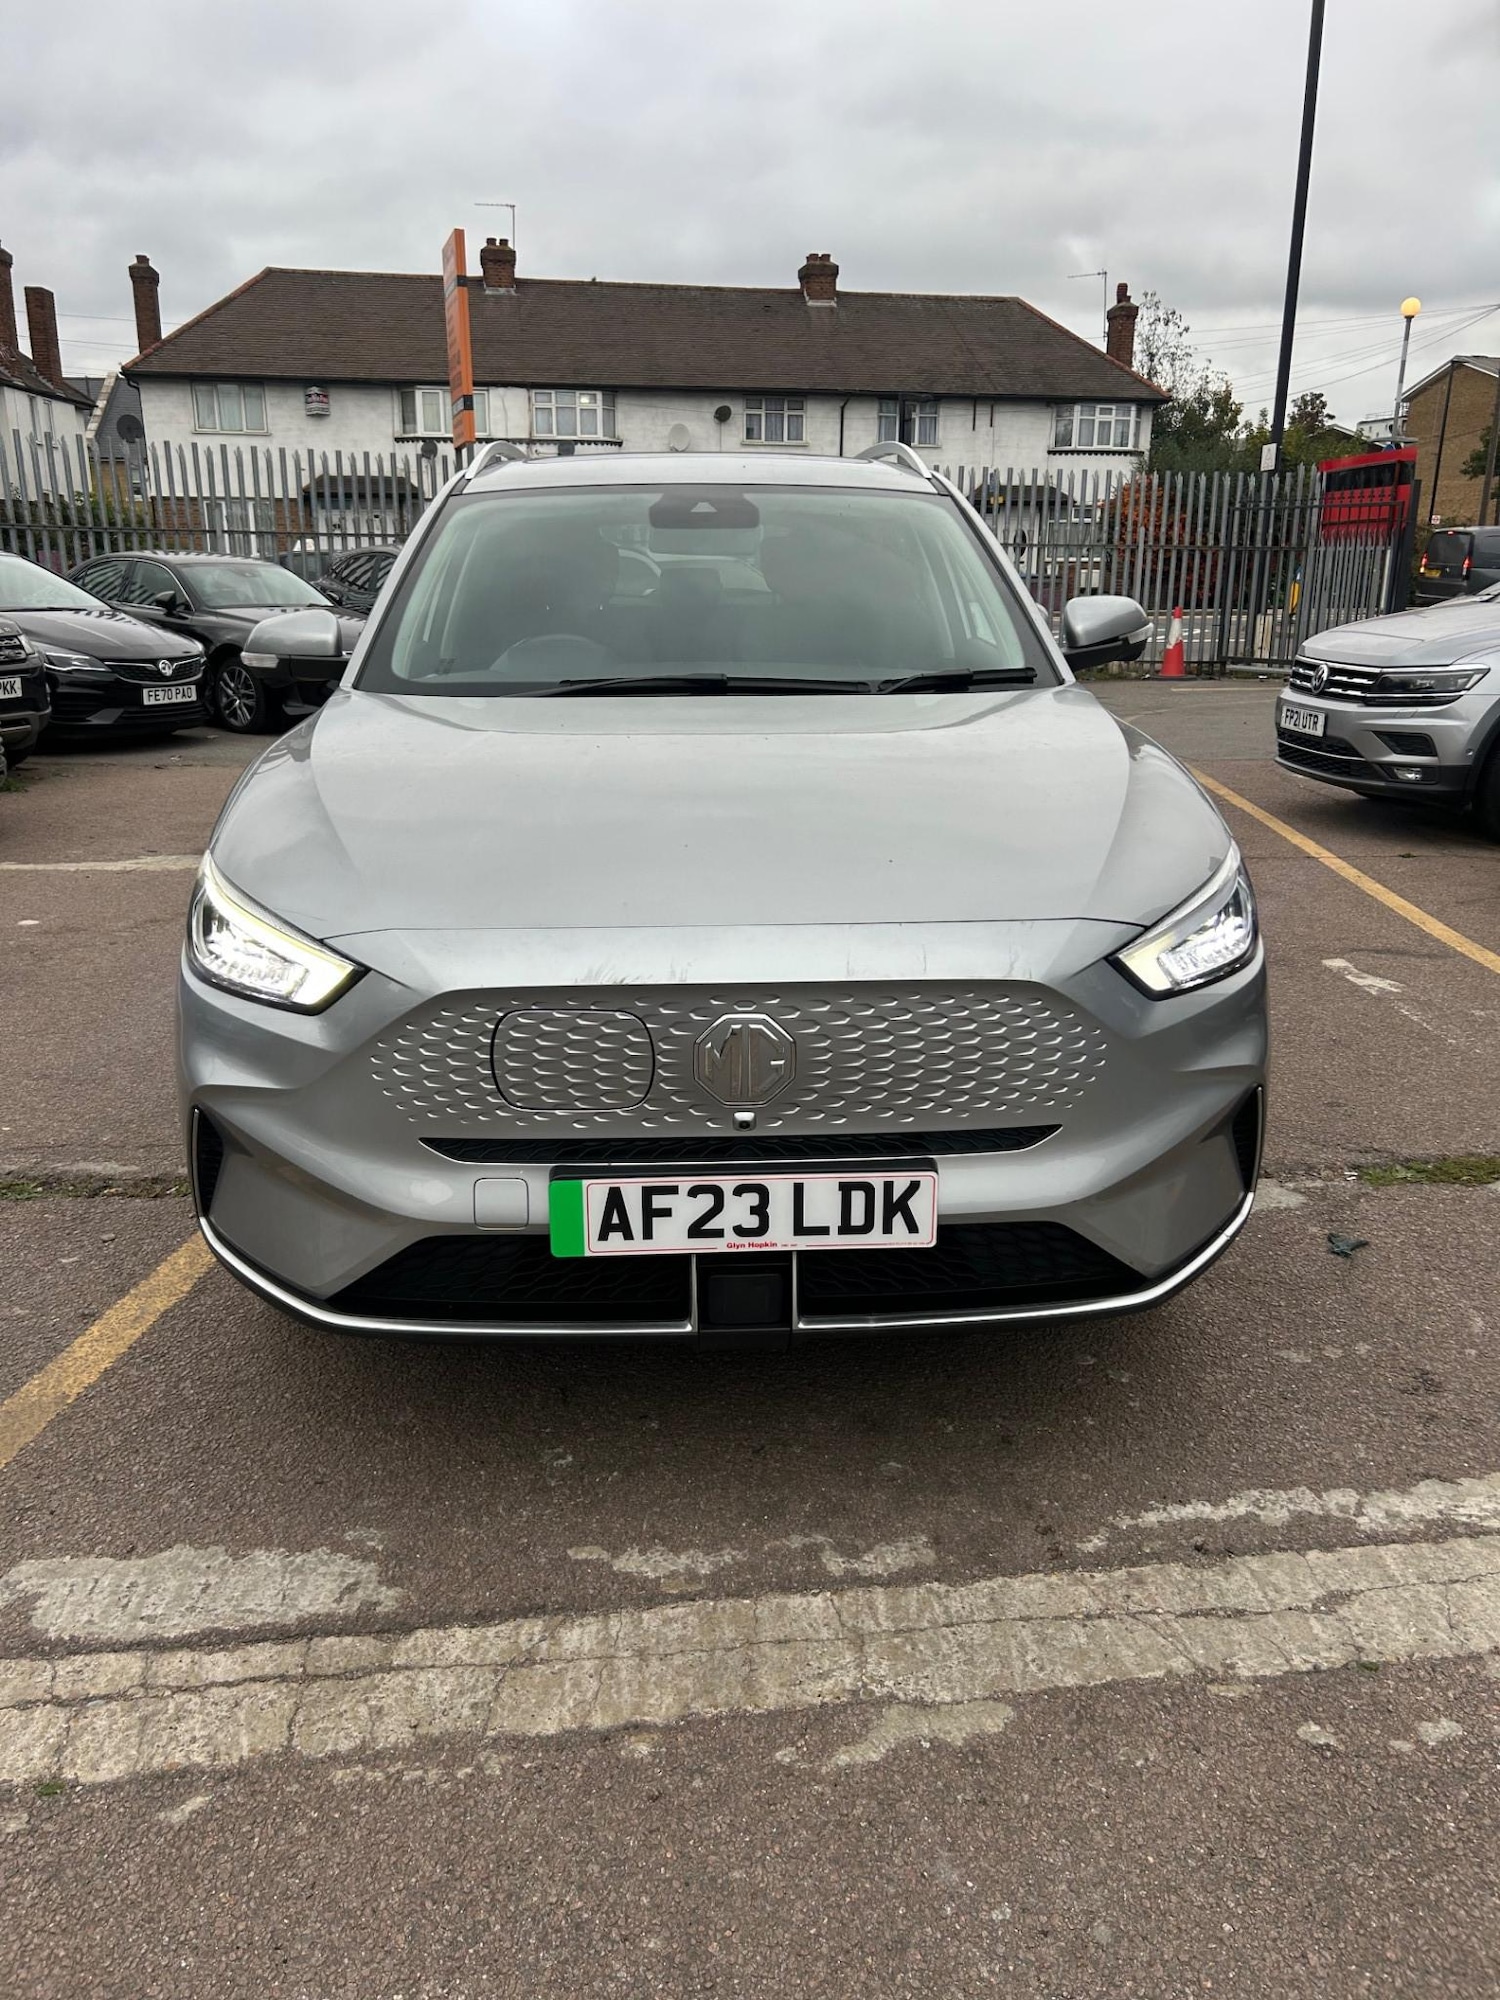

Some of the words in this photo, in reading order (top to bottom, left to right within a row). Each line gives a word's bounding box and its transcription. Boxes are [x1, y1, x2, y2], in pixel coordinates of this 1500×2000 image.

[148, 689, 173, 702] FE70
[1285, 708, 1301, 727] FP21
[1302, 711, 1319, 731] UTR
[705, 1023, 786, 1099] MG
[597, 1183, 770, 1242] AF23
[793, 1180, 922, 1236] LDK
[726, 1242, 746, 1250] Glyn
[748, 1241, 778, 1249] Hopkin
